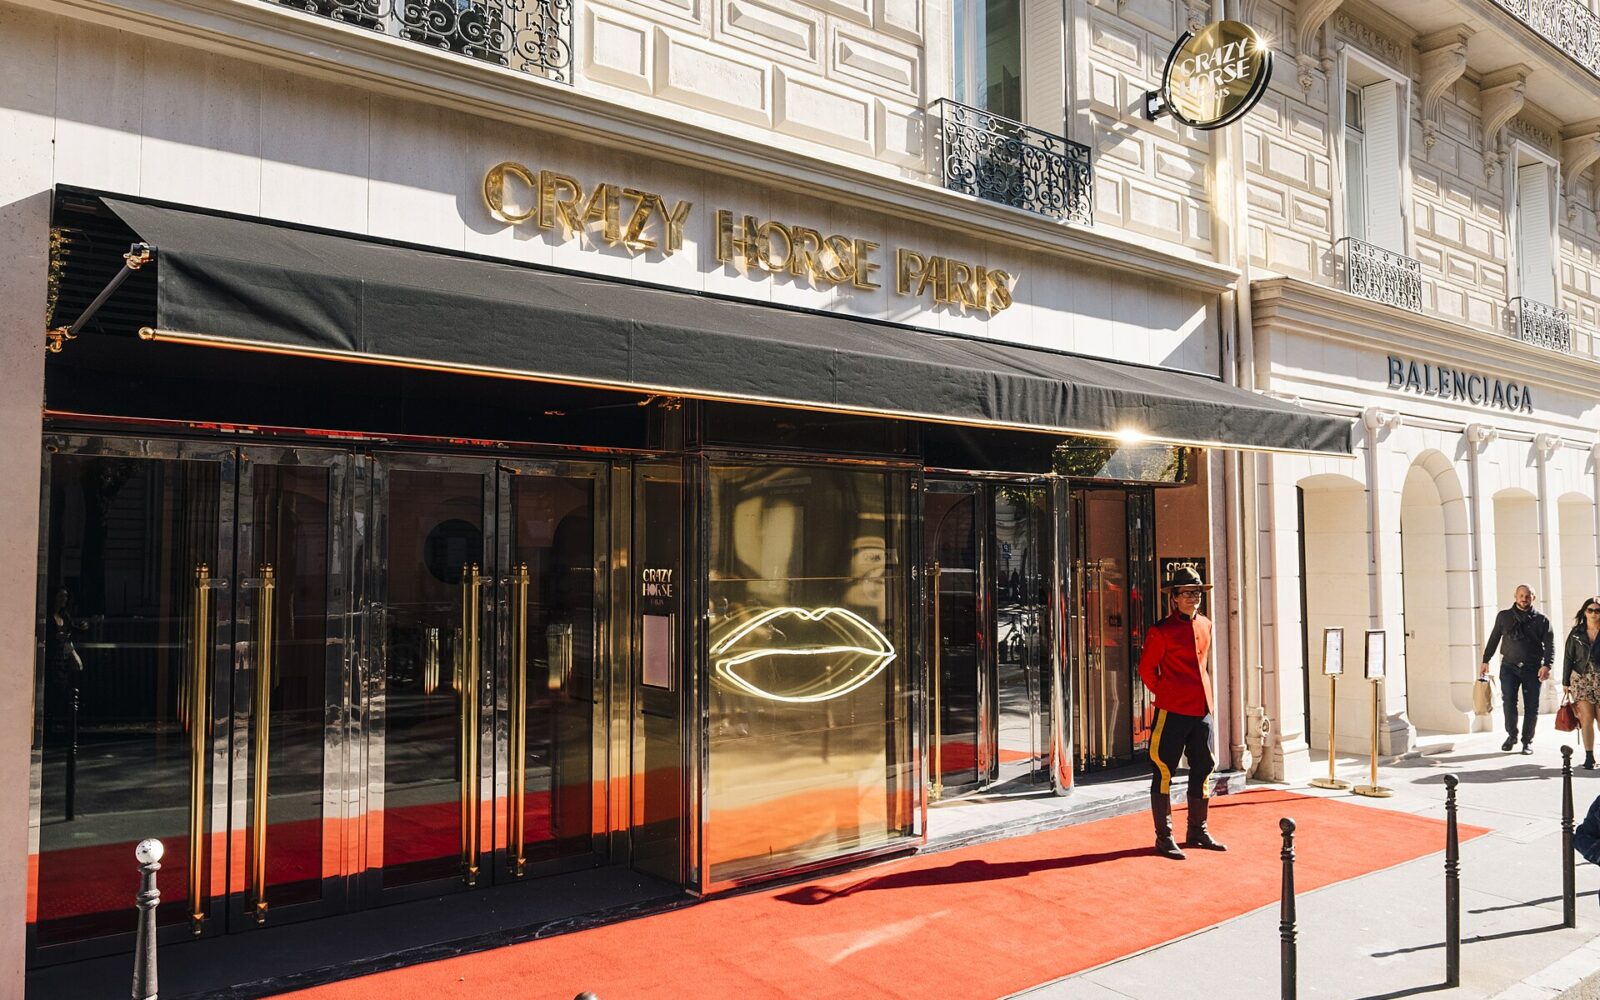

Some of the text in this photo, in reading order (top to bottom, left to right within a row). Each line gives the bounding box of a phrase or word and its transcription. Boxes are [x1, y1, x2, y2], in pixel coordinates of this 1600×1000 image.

[1179, 57, 1250, 97] HORSE
[1180, 37, 1248, 77] CRAZY
[483, 160, 1014, 311] CRAZY HORSE PARIS
[1387, 355, 1534, 415] BALENCIAGA
[642, 568, 673, 583] CRAZY
[642, 582, 673, 598] HORSE
